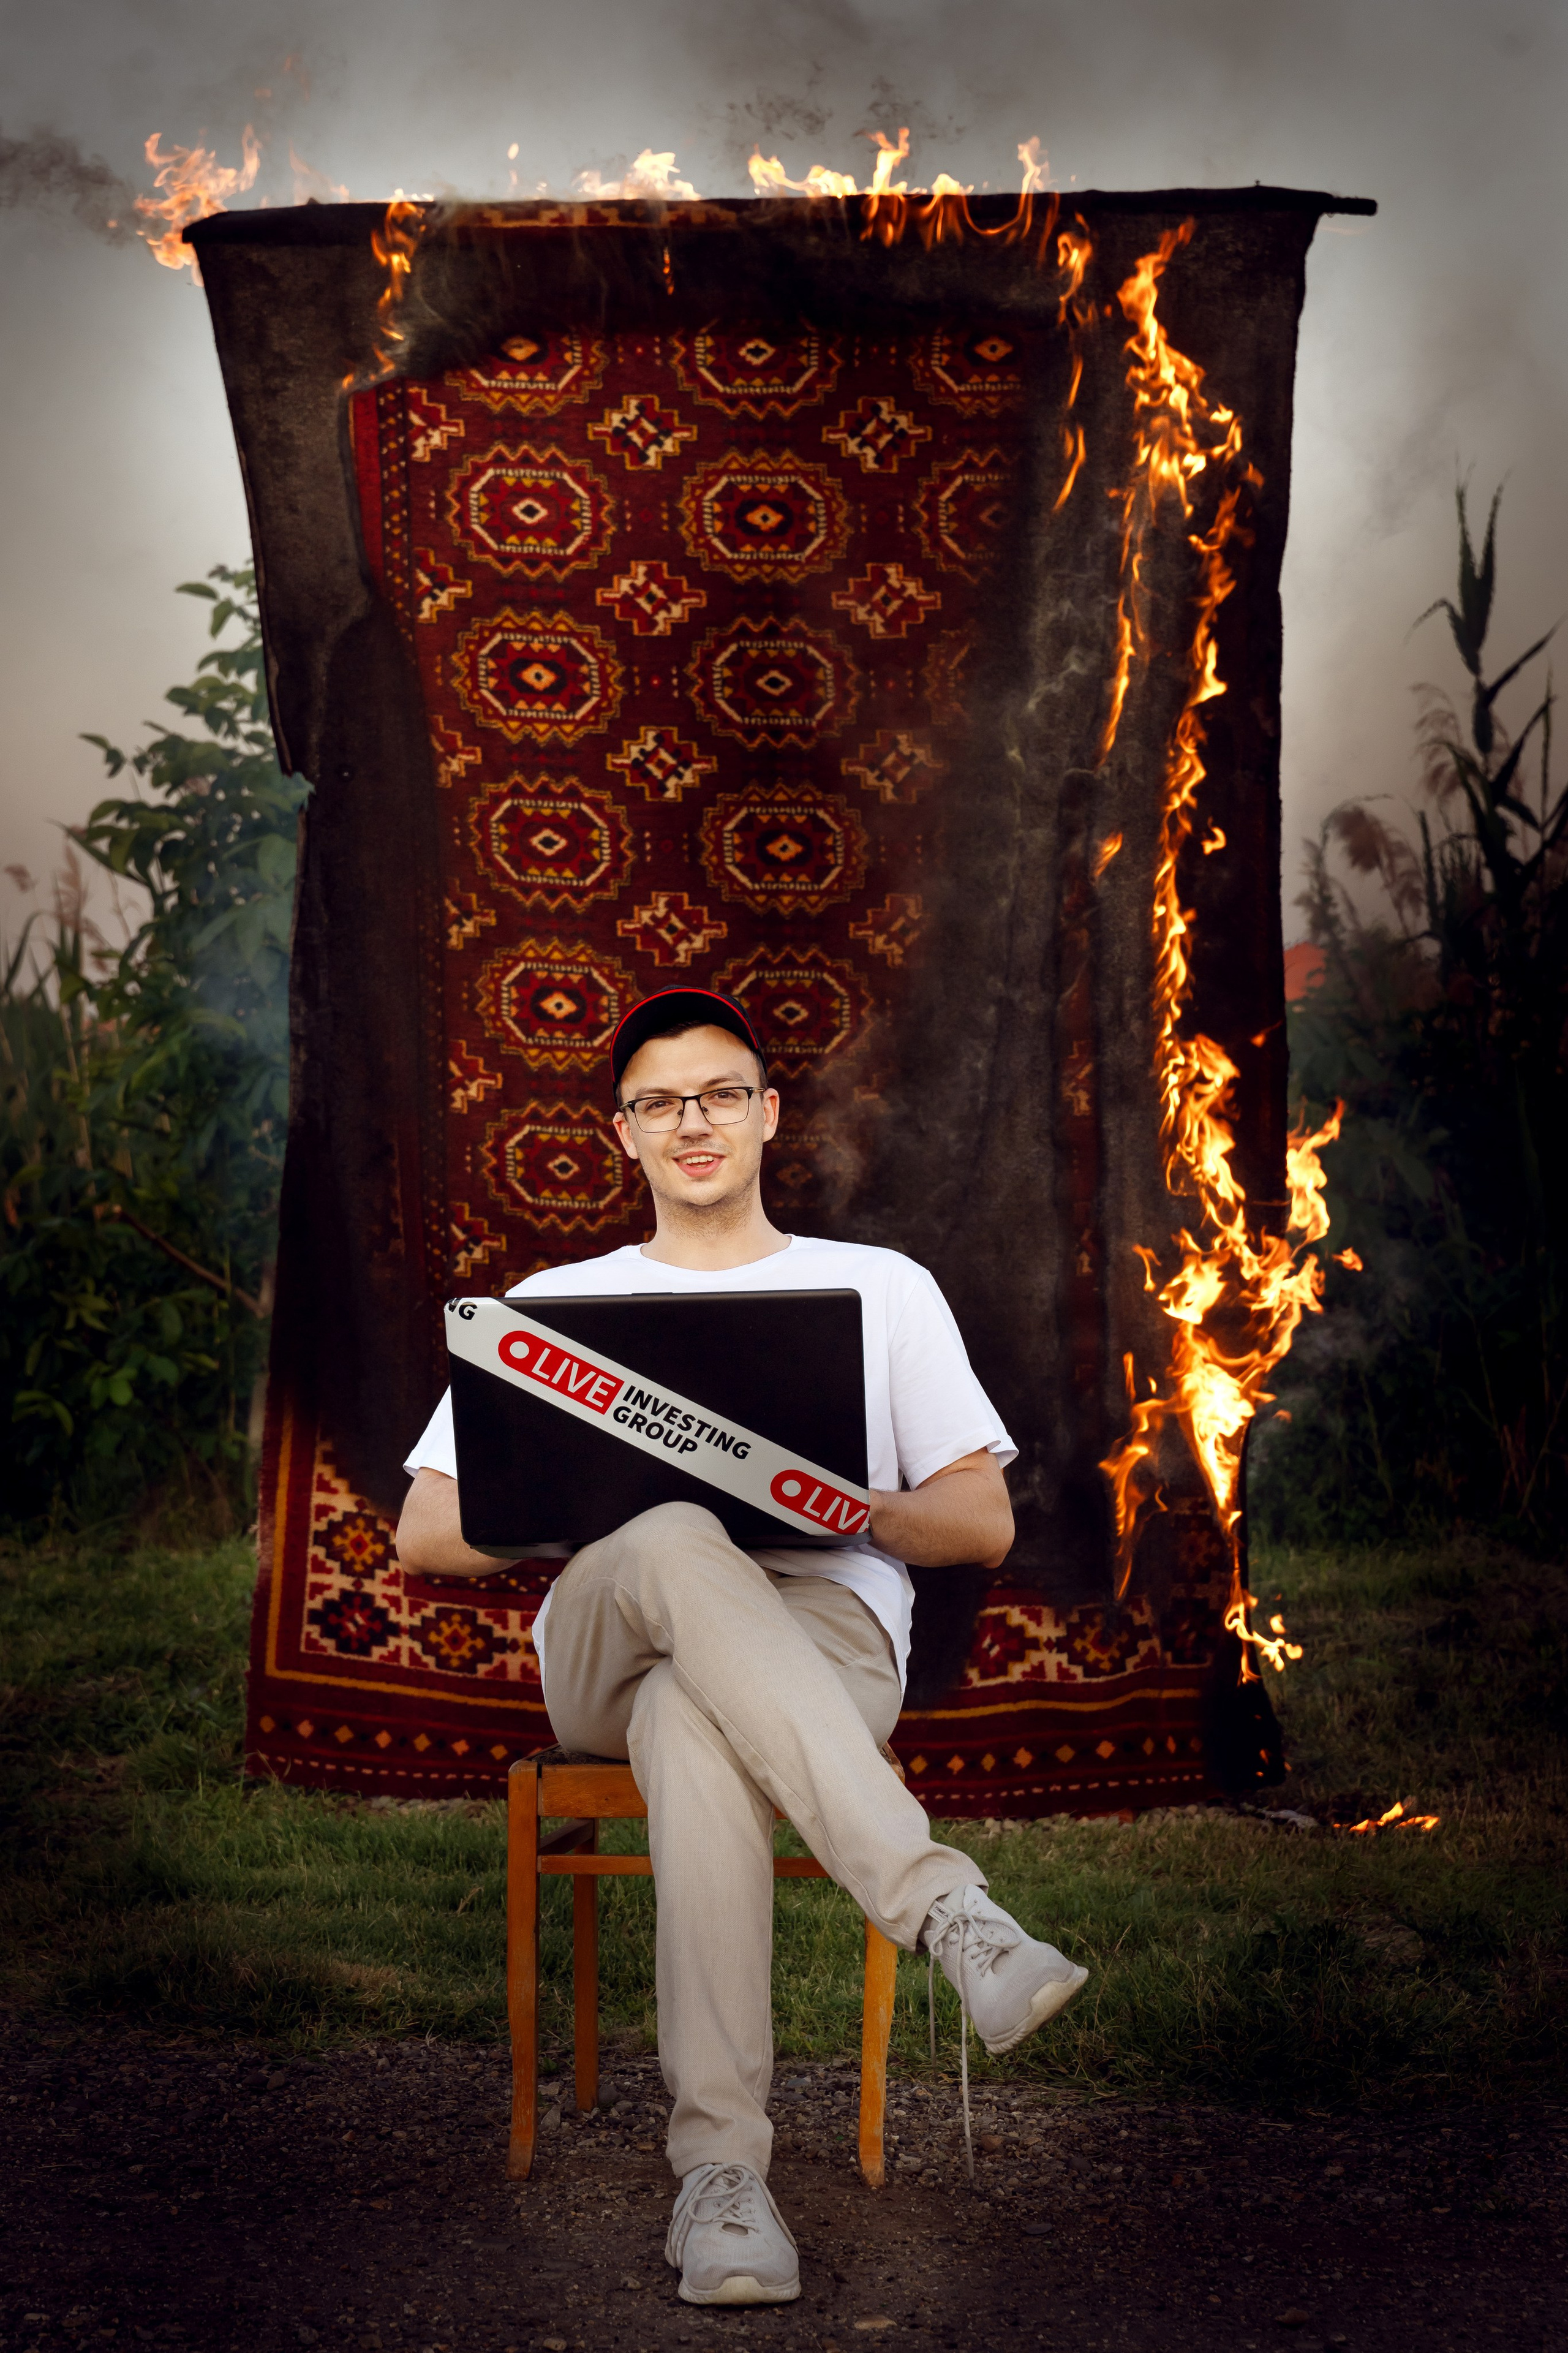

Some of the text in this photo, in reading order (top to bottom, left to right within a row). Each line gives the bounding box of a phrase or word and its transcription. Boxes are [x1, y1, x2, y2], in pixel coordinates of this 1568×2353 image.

[531, 1347, 617, 1408] LIVE
[612, 1405, 698, 1454] GROUP
[622, 1384, 752, 1460] INVESTING
